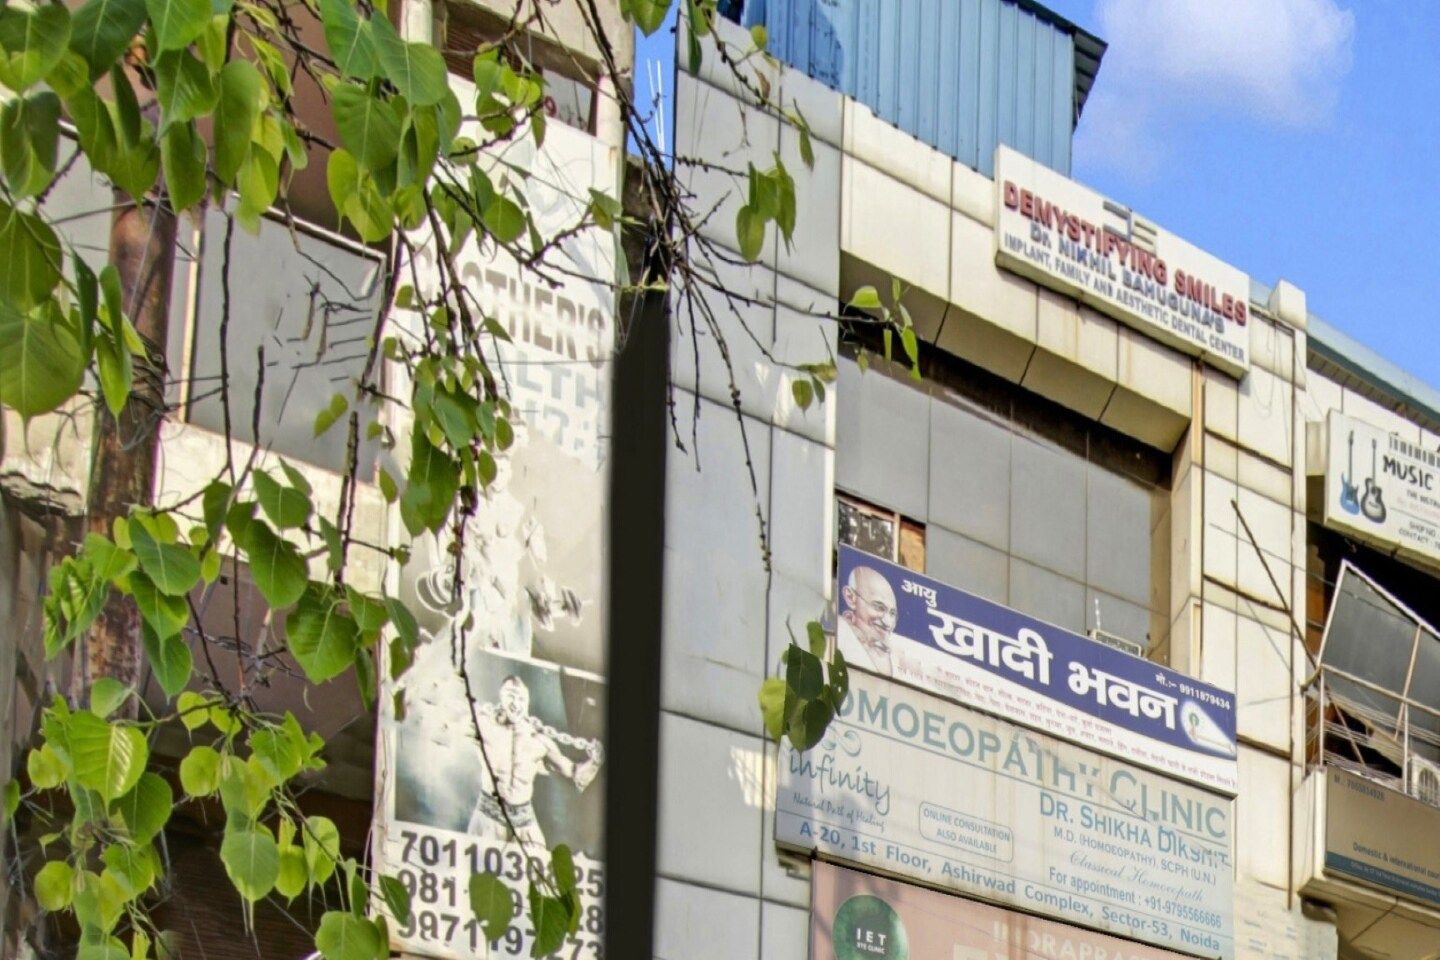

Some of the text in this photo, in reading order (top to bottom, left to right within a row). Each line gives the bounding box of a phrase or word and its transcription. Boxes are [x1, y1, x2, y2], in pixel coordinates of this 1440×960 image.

[1004, 180, 1247, 327] DEMYSTIFYING SMILES
[1058, 237, 1116, 282] NIKHIL
[1055, 253, 1091, 286] FAMILY
[1116, 288, 1169, 324] AESTHETIC
[1171, 315, 1208, 344] DENTAL
[1209, 333, 1245, 361] CENTER
[1383, 455, 1434, 491] MUSIC
[901, 579, 938, 609] आयु
[928, 607, 1054, 687] खादी
[1067, 660, 1179, 731] भवन
[922, 807, 1011, 842] ONLINE CONSULTATION
[1039, 791, 1152, 848] DR. SHIKHA
[1110, 769, 1227, 839] CLINIC
[936, 828, 958, 842] ALSO
[1053, 826, 1077, 844] M.D.
[799, 821, 846, 848] A-20,
[850, 836, 877, 857] 1st
[885, 844, 932, 874] Floor,
[941, 861, 1017, 895] Ashirwad
[1024, 884, 1095, 920] Complex,
[1101, 904, 1174, 941] Sector-53,
[1180, 927, 1221, 951] Noida
[1048, 866, 1136, 908] For appointment
